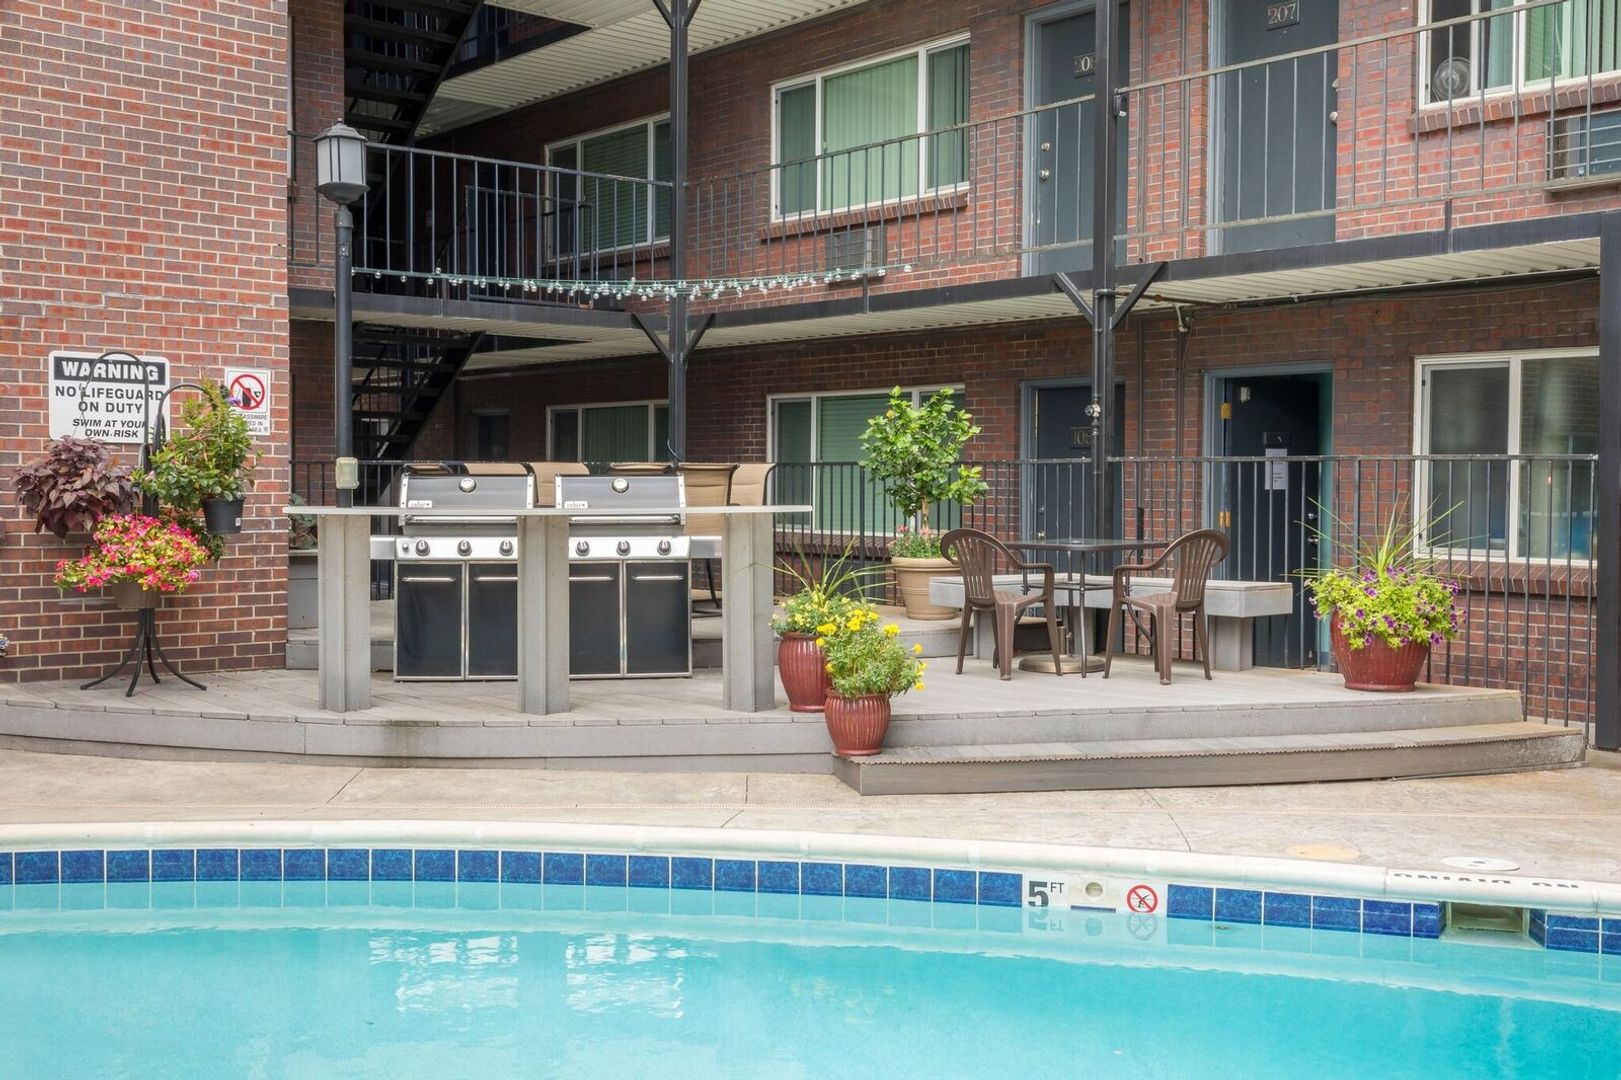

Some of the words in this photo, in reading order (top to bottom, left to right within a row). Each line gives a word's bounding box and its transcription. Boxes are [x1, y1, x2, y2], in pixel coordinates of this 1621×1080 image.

[1267, 3, 1297, 25] 207
[61, 360, 160, 382] WARNING
[55, 385, 77, 397] NO
[78, 401, 99, 412] ON
[105, 402, 143, 414] DUTY
[72, 418, 102, 428] SWIM
[104, 419, 118, 428] AT
[1028, 880, 1050, 908] 5
[1050, 881, 1065, 894] FT
